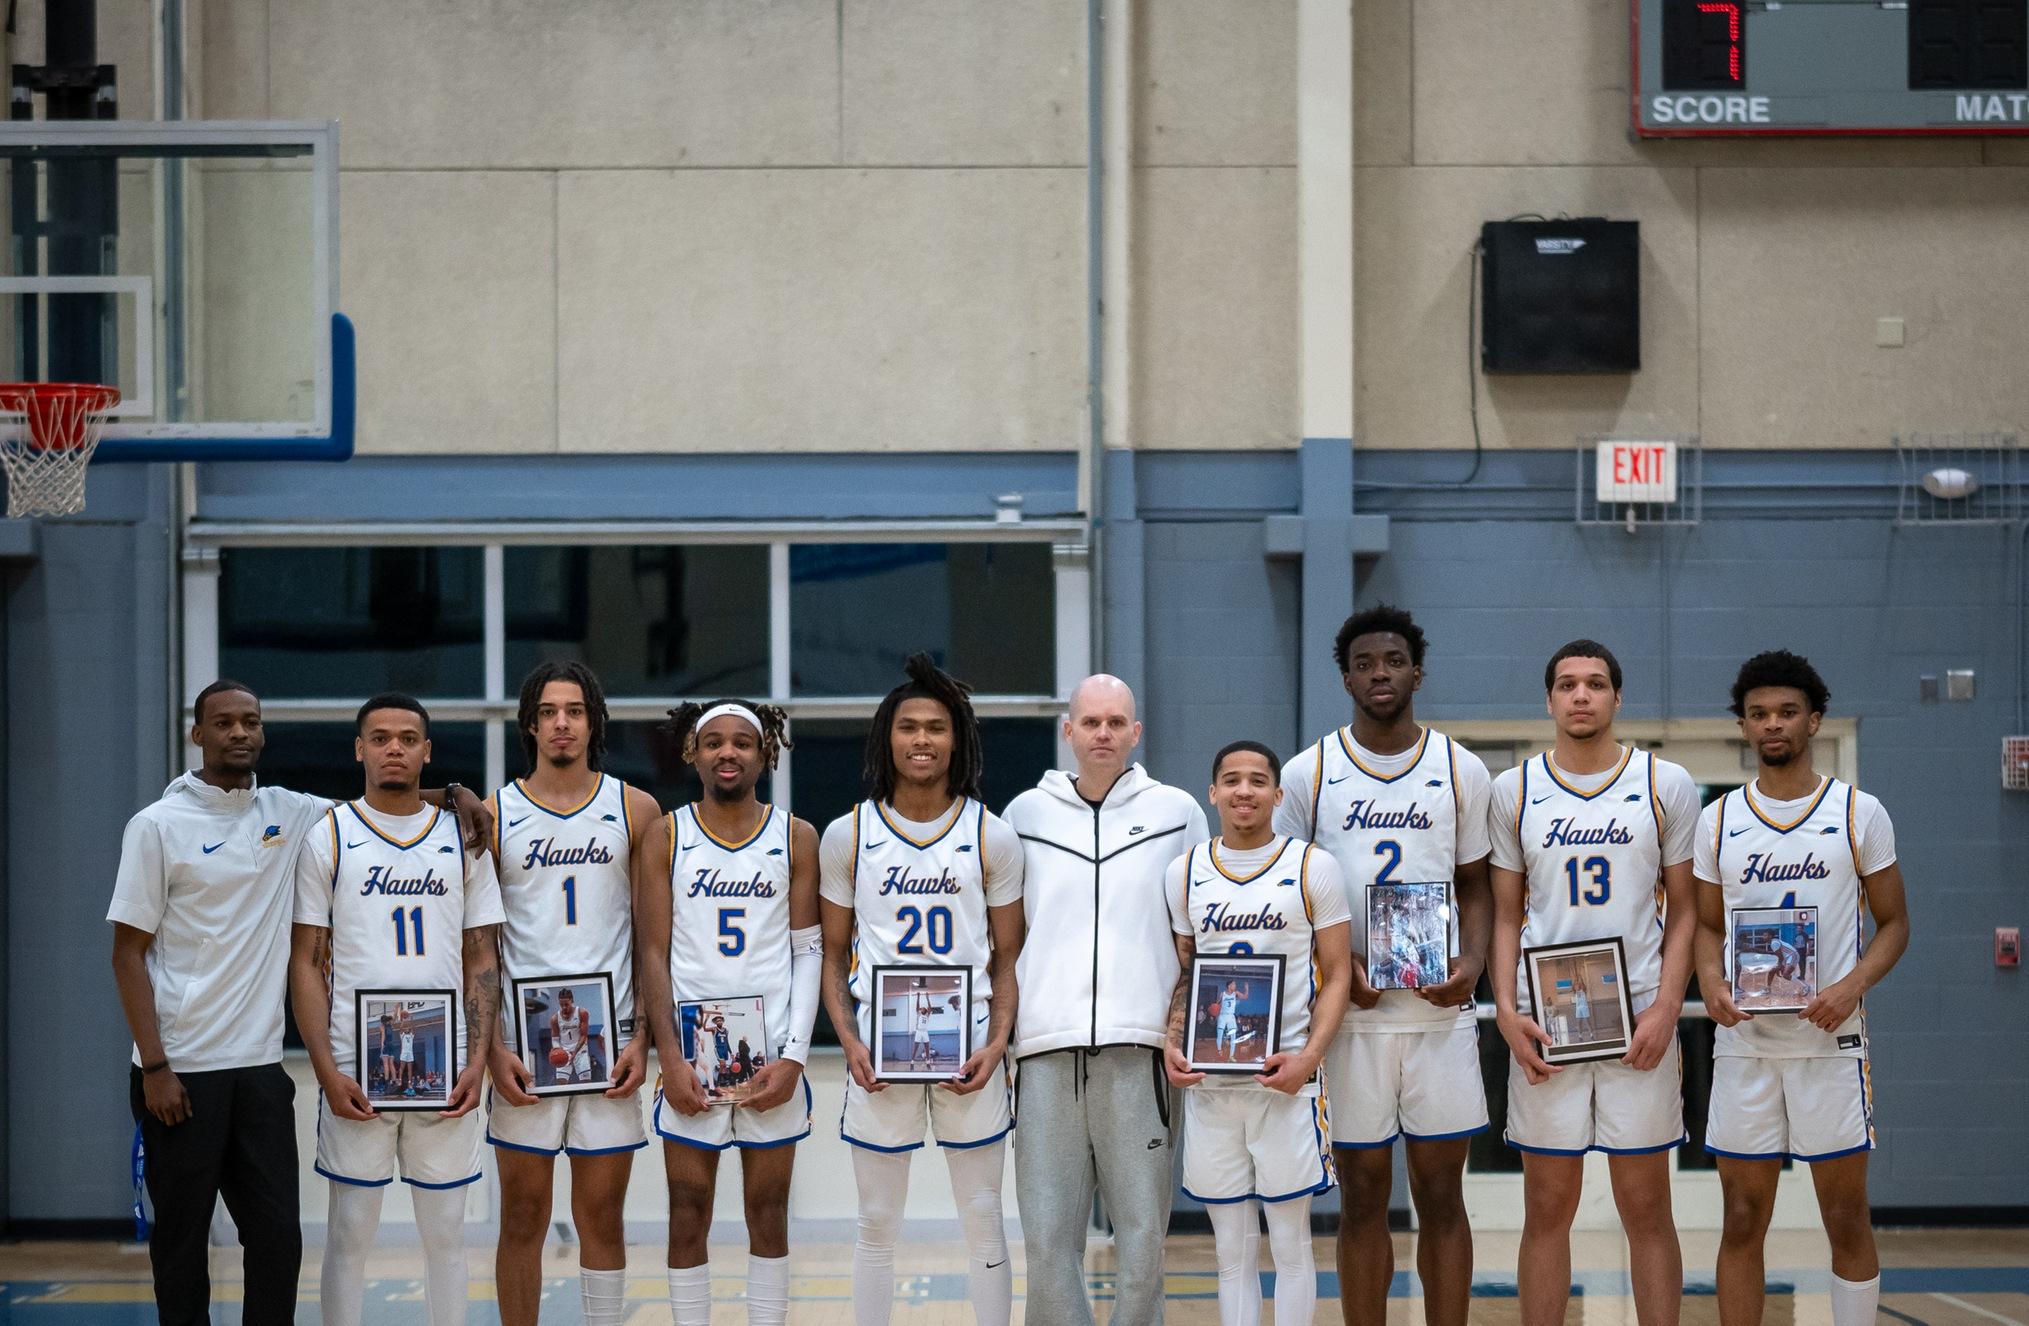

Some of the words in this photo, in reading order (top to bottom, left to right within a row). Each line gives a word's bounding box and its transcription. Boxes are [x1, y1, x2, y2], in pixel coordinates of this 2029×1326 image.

[1698, 3, 1740, 80] 7
[1652, 96, 1771, 123] SCORE
[1955, 95, 2029, 121] MAT
[1613, 447, 1665, 485] EXIT
[1342, 798, 1433, 831] Hawks
[1542, 817, 1634, 849] Hawks
[522, 836, 614, 871] Hawks
[1373, 839, 1405, 885] 2
[1740, 851, 1831, 885] Hawks
[360, 865, 448, 897] Hawks
[687, 867, 778, 898] Hawks
[879, 865, 961, 897] Hawks
[1565, 854, 1612, 907] 13
[561, 874, 577, 927] 1
[390, 904, 427, 957] 11
[717, 906, 746, 957] 5
[896, 904, 955, 956] 20
[1202, 902, 1288, 934] Hawks
